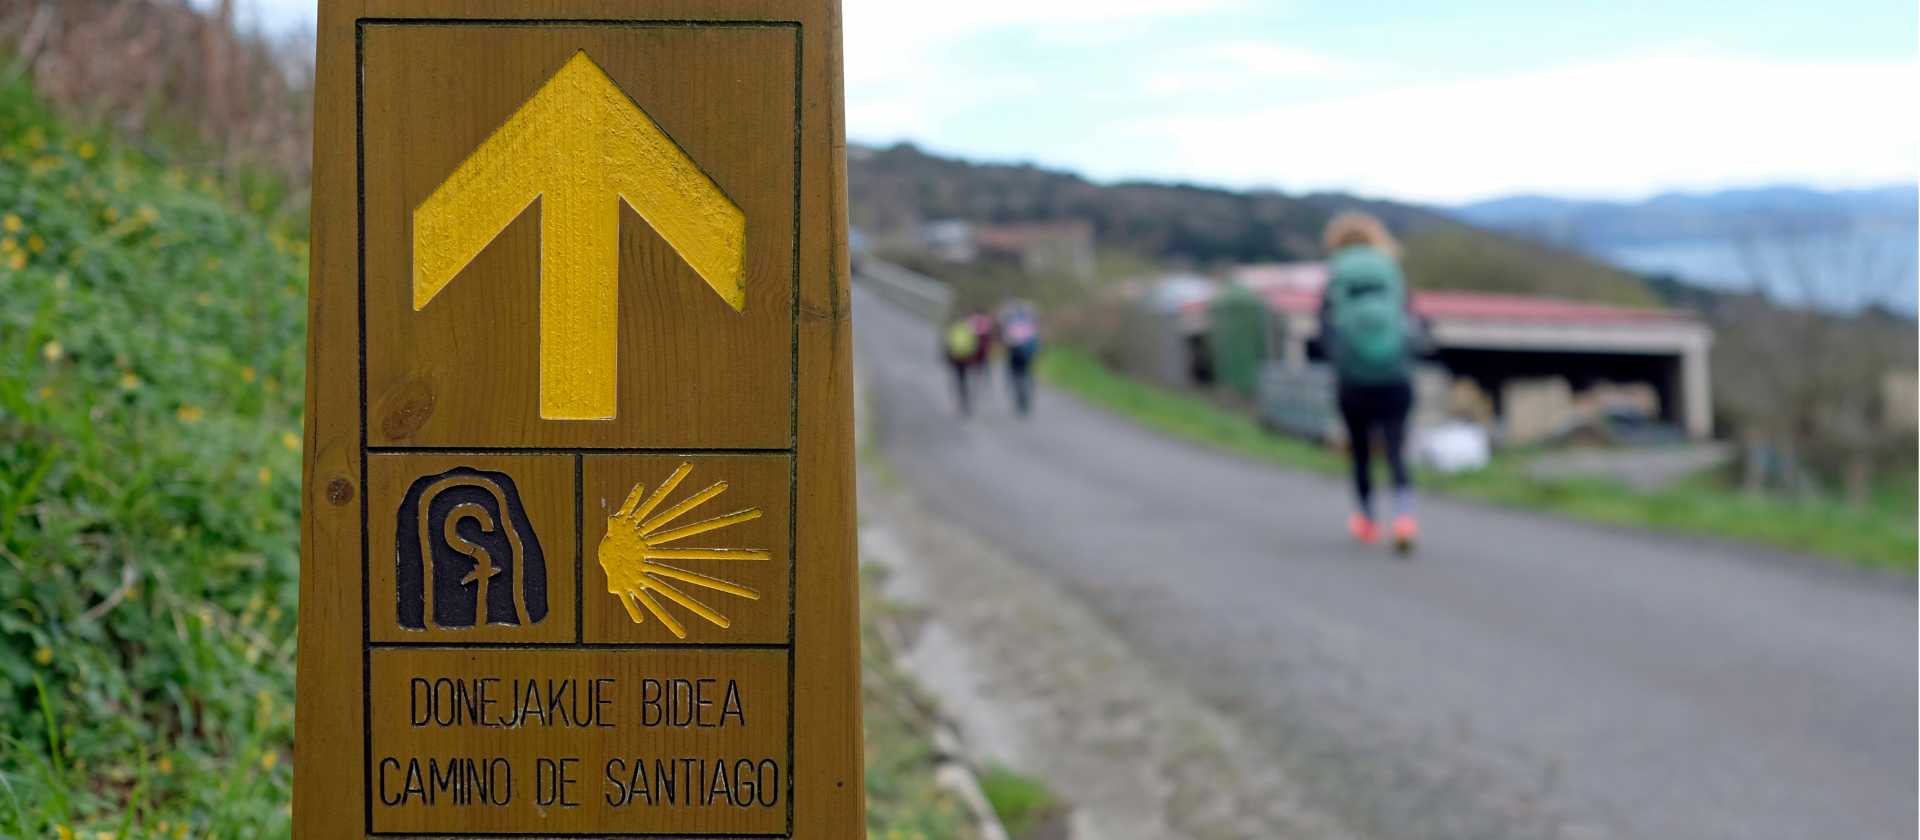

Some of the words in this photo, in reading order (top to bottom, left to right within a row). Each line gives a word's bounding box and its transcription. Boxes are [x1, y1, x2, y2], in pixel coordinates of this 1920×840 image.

[410, 677, 616, 728] DONEJAKUE
[641, 678, 745, 728] BIDEA
[378, 757, 512, 807] CAMINO
[536, 758, 580, 807] DE
[605, 757, 779, 808] SANTIAGO
